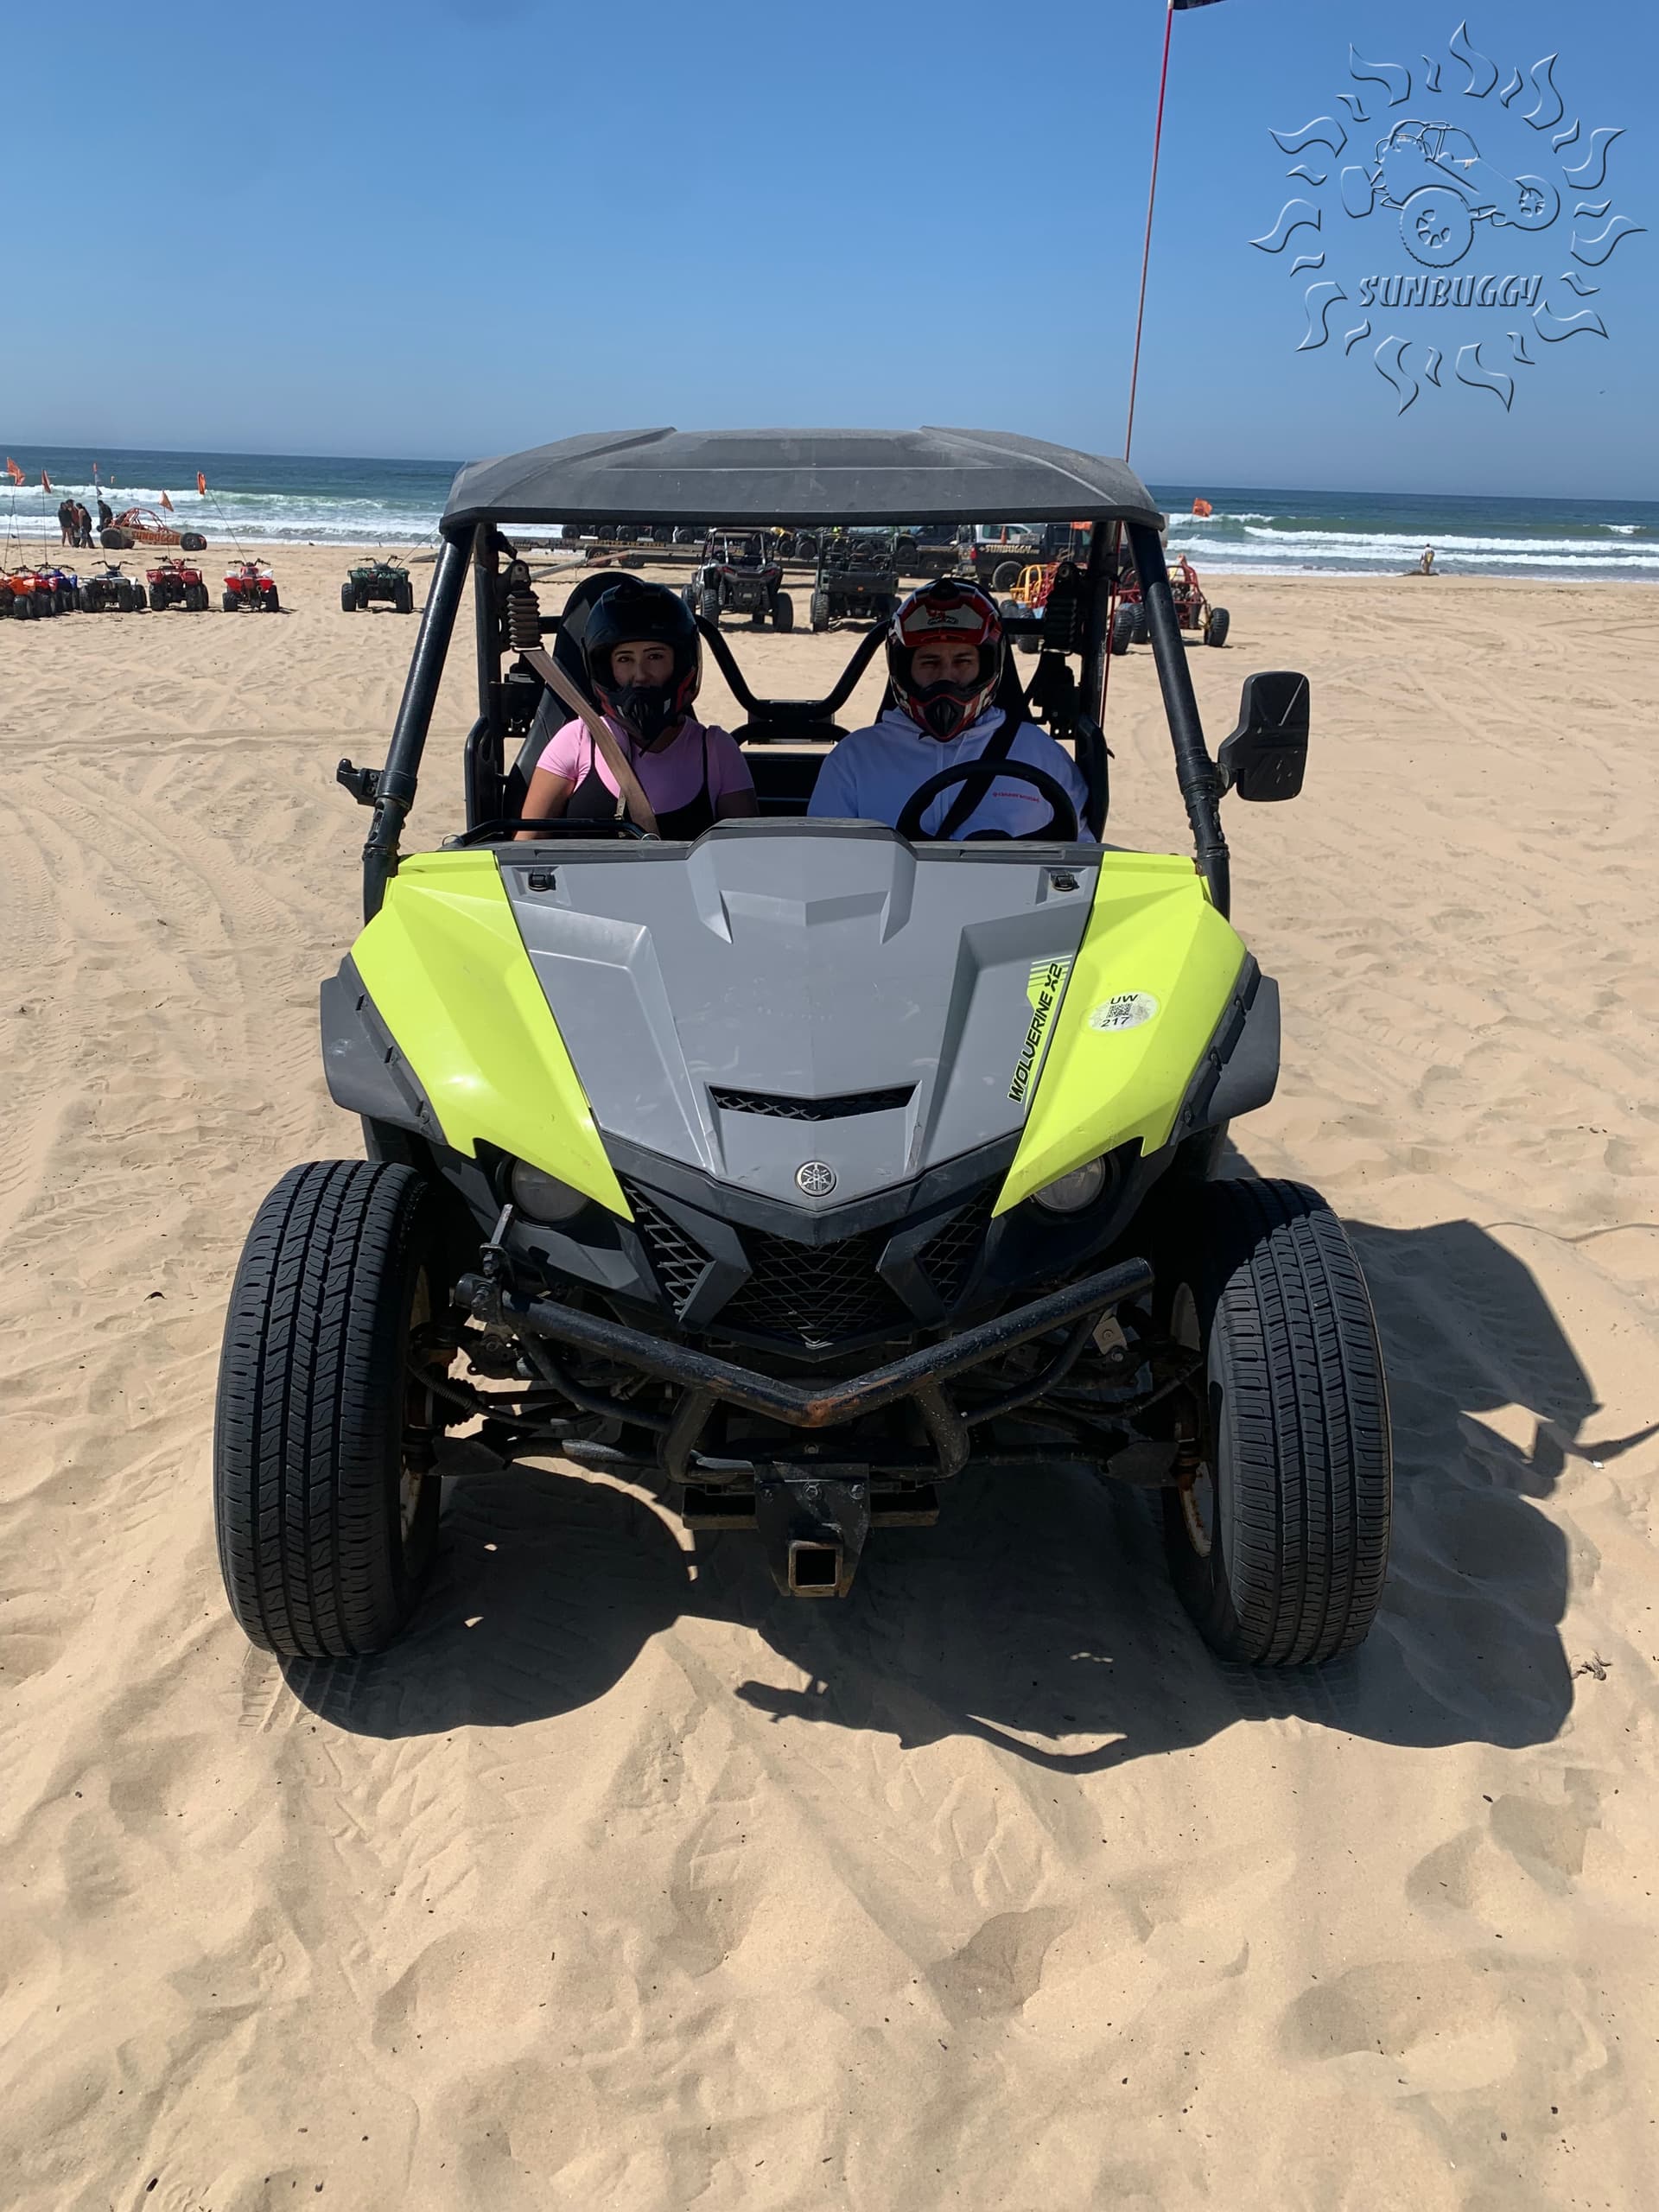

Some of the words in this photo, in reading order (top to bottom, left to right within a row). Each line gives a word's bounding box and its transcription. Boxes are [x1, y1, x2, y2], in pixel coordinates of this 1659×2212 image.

[1110, 994, 1139, 1004] UW
[1101, 1016, 1130, 1027] 217
[1008, 990, 1053, 1103] WOLVERINE
[1045, 963, 1063, 992] X2
